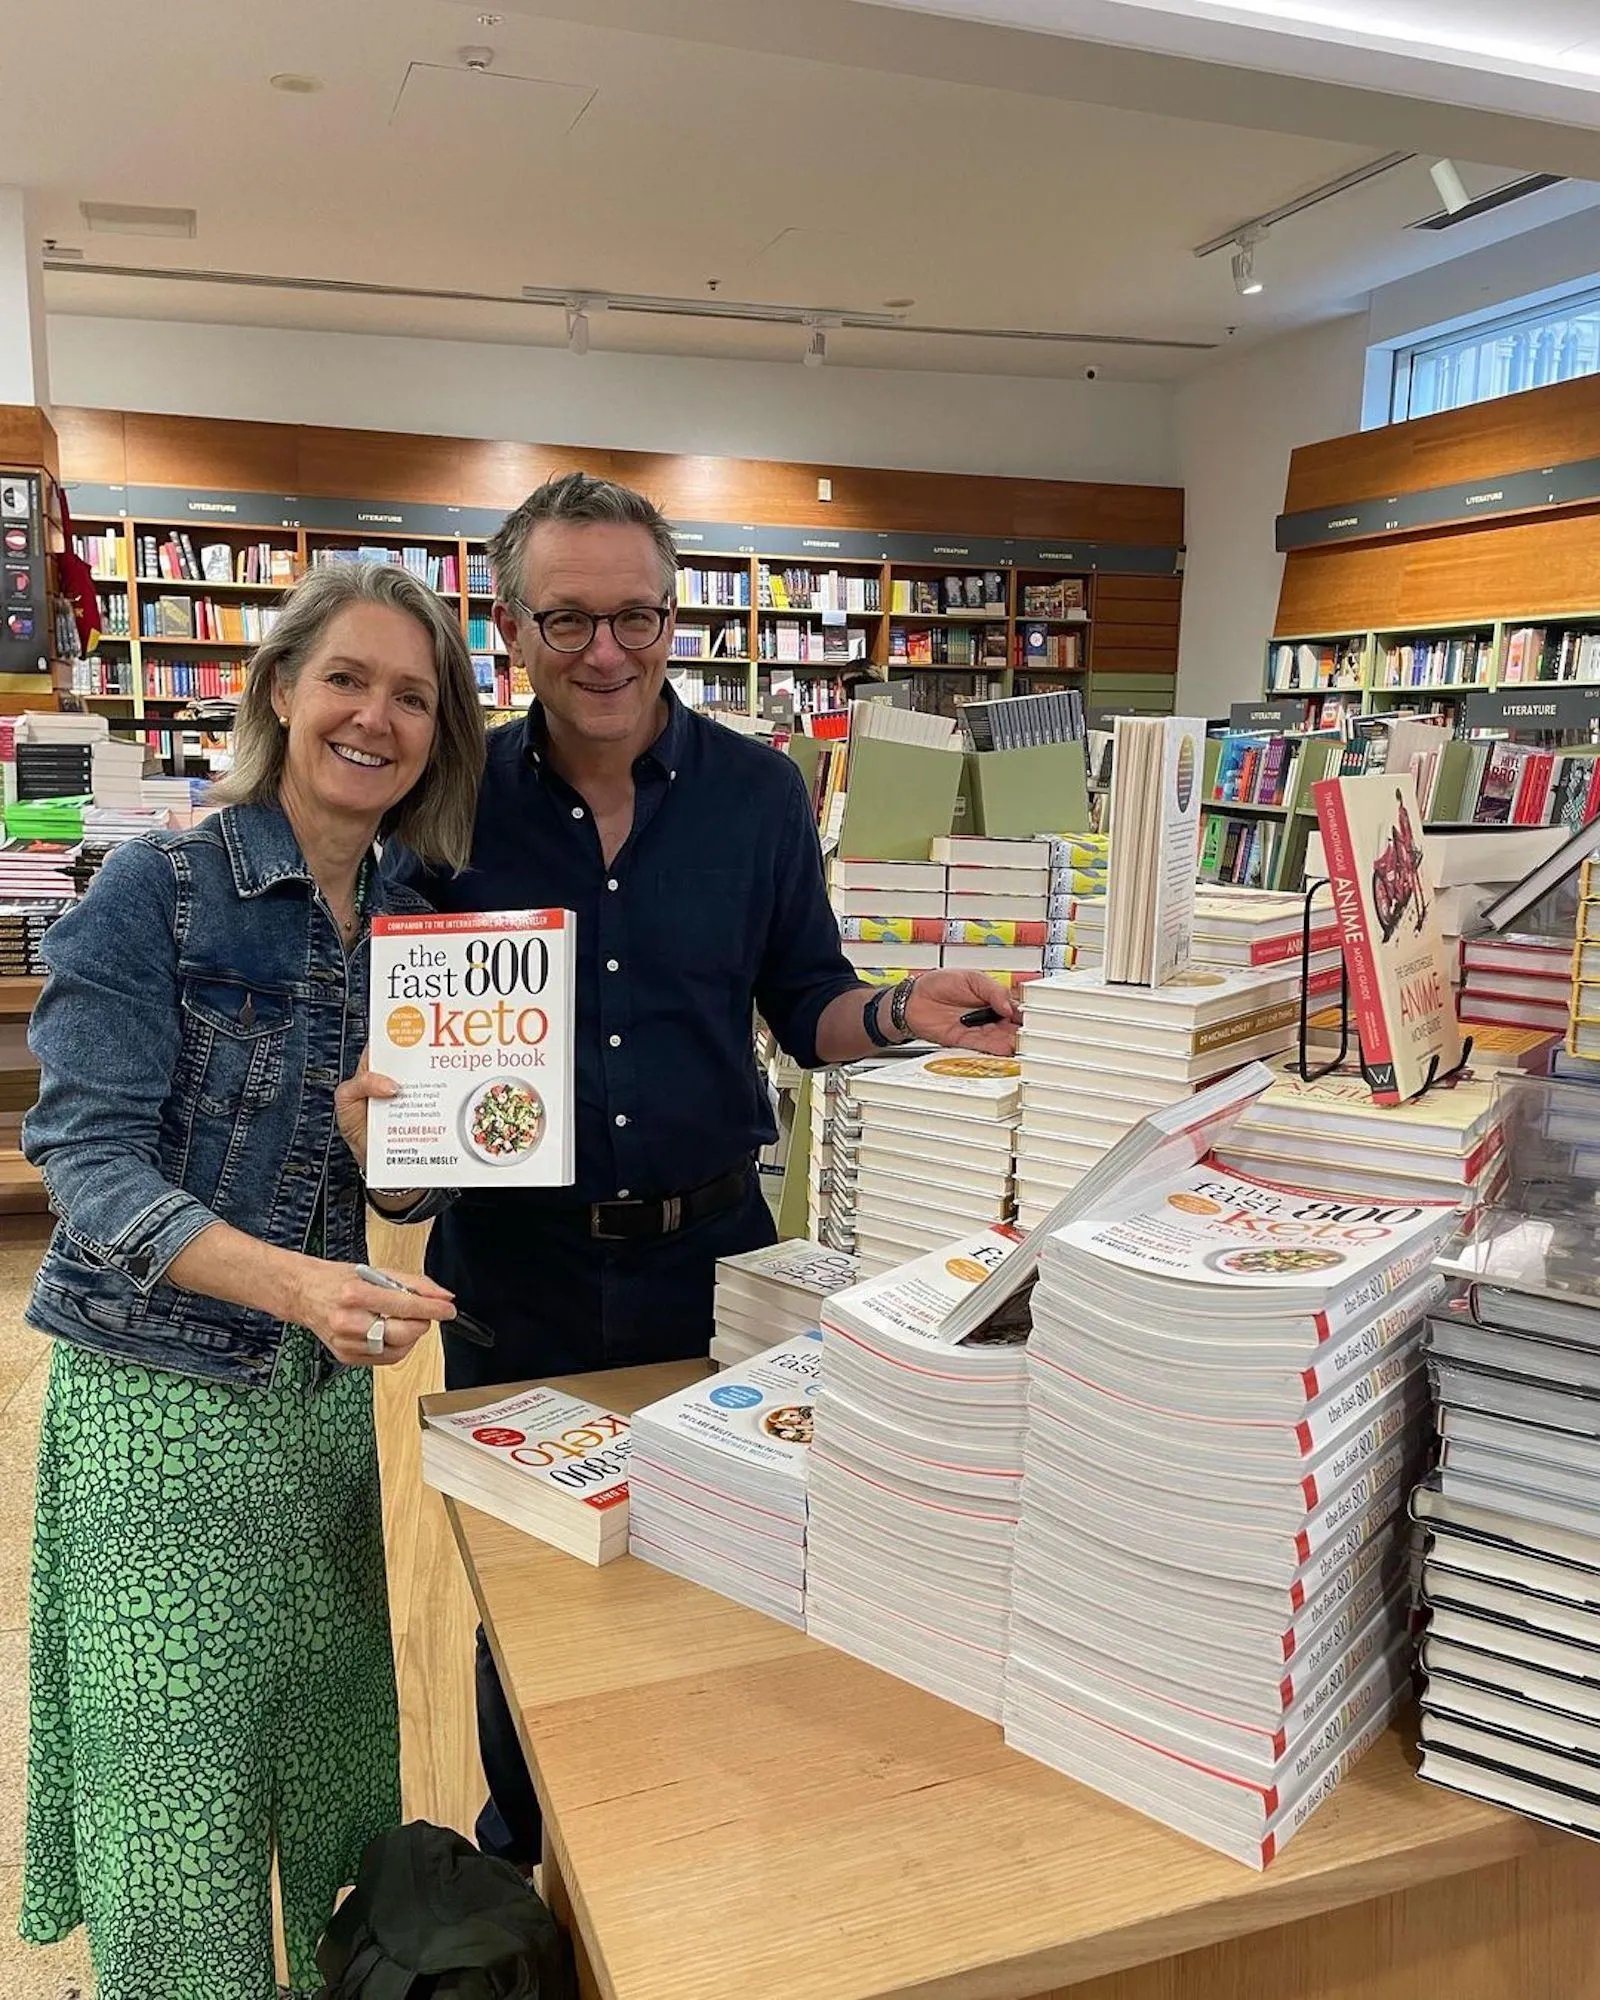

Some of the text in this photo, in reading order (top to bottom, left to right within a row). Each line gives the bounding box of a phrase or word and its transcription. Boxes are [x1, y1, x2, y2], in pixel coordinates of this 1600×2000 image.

[188, 503, 236, 513] LITERATURE
[1466, 492, 1503, 505] LITERATURE
[358, 514, 403, 523] LITERATURE
[1328, 517, 1358, 529] LITERATURE
[802, 540, 840, 548] LITERATURE
[933, 547, 969, 555] LITERATURE
[1251, 712, 1281, 720] LITERATURE
[1503, 704, 1557, 716] LITERATURE
[388, 921, 423, 931] COMPANION
[424, 920, 433, 930] TO
[433, 920, 445, 929] THE
[1334, 877, 1364, 944] ANIME
[387, 937, 549, 999] fast 800
[409, 945, 446, 967] the
[1354, 947, 1365, 973] MOVIE
[1358, 974, 1371, 1000] GUIDE
[1399, 971, 1444, 1027] ANIME
[429, 1001, 548, 1047] keto
[430, 1048, 545, 1071] recipe book
[1368, 1065, 1392, 1084] W
[387, 1126, 447, 1135] DR CLARE BAILEY
[386, 1156, 458, 1166] DR MICHAEL MOSLEY
[1189, 1182, 1281, 1216] fast
[1293, 1202, 1423, 1225] 800
[1234, 1186, 1282, 1203] the
[1214, 1208, 1392, 1240] keto
[1091, 1236, 1105, 1245] DR
[1105, 1239, 1147, 1259] MICHAEL
[1148, 1255, 1191, 1269] MOSLEY
[1155, 1241, 1192, 1255] BAILEY
[1344, 1259, 1412, 1315] the fast 800 keto
[875, 1305, 906, 1328] MICHAEL
[907, 1325, 938, 1341] MOSLEY
[1335, 1310, 1407, 1370] the fast 800 keto
[1329, 1359, 1400, 1423] the fast 800 keto
[491, 1399, 531, 1417] MICHAEL
[511, 1414, 631, 1466] keto
[689, 1417, 709, 1429] CLARE
[709, 1424, 733, 1437] BAILEY
[1333, 1410, 1400, 1477] the fast 800 keto
[550, 1457, 621, 1488] 800
[1325, 1457, 1394, 1529] the fast 800 keto
[1320, 1500, 1389, 1577] the fast 800 keto
[1311, 1543, 1378, 1623] the fast 800 keto
[1309, 1587, 1374, 1671] the fast 800 keto
[1303, 1635, 1373, 1720] the fast 800 keto
[1295, 1685, 1372, 1776] the fast 800 keto
[1294, 1733, 1371, 1826] the fast 800 keto
